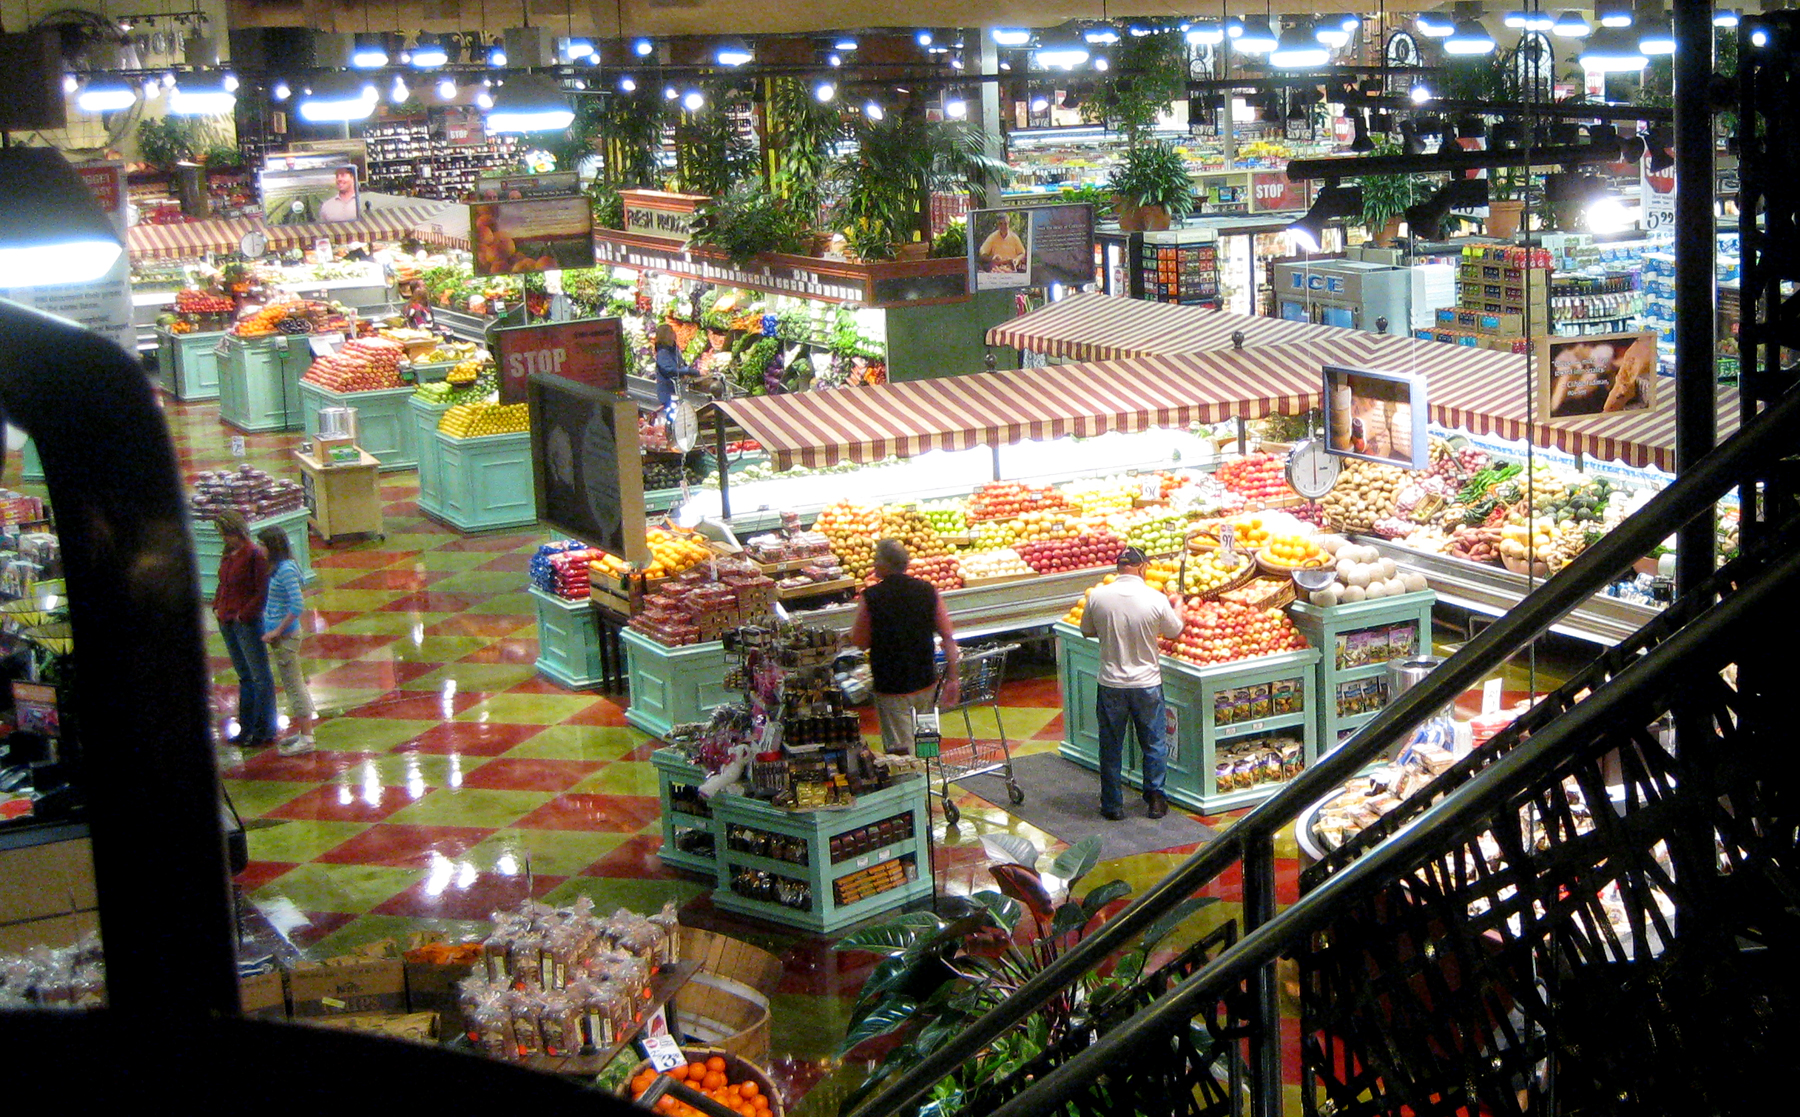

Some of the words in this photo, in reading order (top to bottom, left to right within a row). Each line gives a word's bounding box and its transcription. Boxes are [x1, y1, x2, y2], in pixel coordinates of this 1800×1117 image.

[450, 130, 468, 139] STOP
[1256, 184, 1284, 199] STOP
[1291, 272, 1344, 294] ICE
[509, 348, 567, 378] STOP
